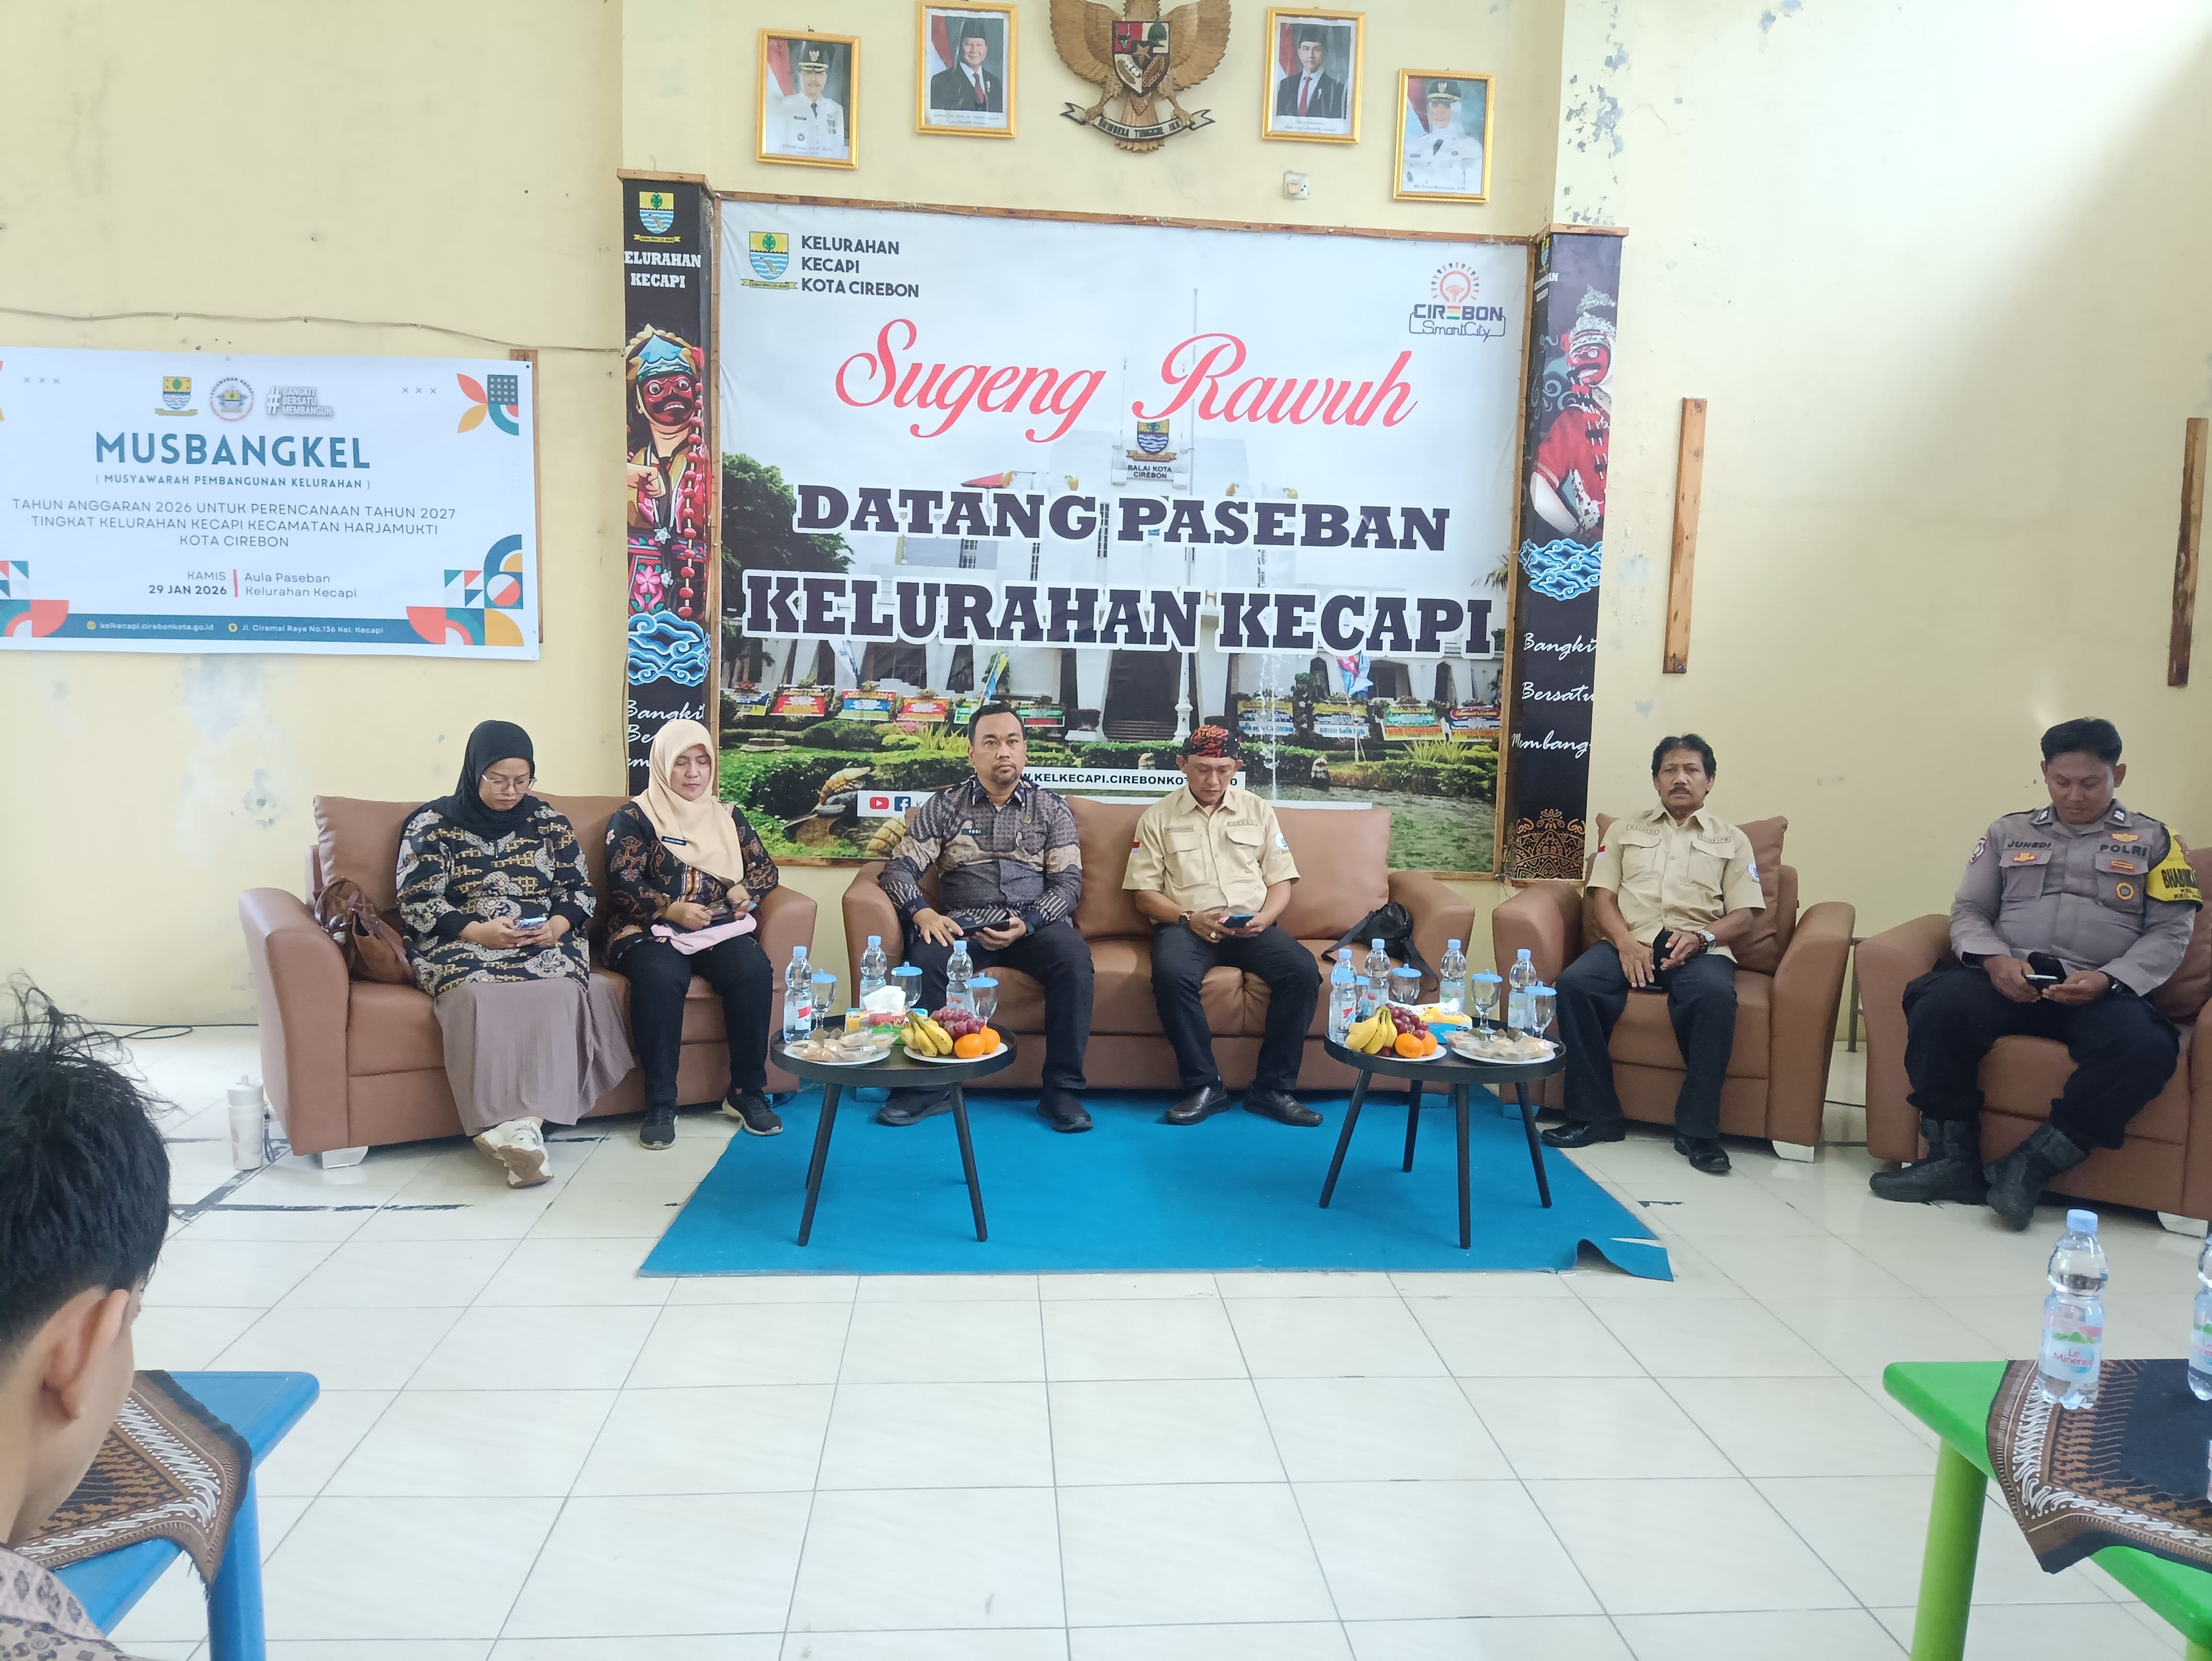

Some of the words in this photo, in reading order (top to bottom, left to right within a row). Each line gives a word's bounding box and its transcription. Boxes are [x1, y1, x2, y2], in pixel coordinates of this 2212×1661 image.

[801, 235, 899, 255] KELURAHAN
[624, 251, 701, 268] ELURAHAN
[801, 257, 860, 274] KECAPI
[630, 273, 686, 288] KECAPI
[801, 277, 846, 294] KOTA
[849, 280, 919, 298] CIREBON
[835, 319, 1106, 443] Sugeng
[1132, 333, 1418, 427] Rawuh
[282, 406, 333, 416] MEMBANGUN
[96, 432, 370, 468] MUSBANGKEL
[104, 475, 189, 484] MUSYAWARAH
[195, 476, 286, 487] PEMBANGUNAN
[292, 478, 362, 488] KELURAHAN
[13, 499, 63, 510] TAHUN
[68, 500, 151, 512] ANGGARAN
[156, 501, 192, 512] 2026
[197, 503, 246, 514] UNTUK
[252, 504, 360, 517] PERENCANAAN
[365, 506, 415, 518] TAHUN
[420, 508, 455, 519] 2027
[32, 516, 95, 527] TINGKAT
[100, 517, 187, 529] KELURAHAN
[192, 519, 243, 530] KECAPI
[249, 520, 339, 532] KECAMATAN
[345, 522, 438, 534] HARJAMUKTI
[797, 485, 1097, 540] DATANG
[1117, 498, 1450, 551] PASEBAN
[180, 535, 219, 546] KOTA
[224, 535, 289, 547] CIREBON
[188, 571, 226, 581] KAMIS
[245, 573, 272, 582] Aula
[276, 573, 330, 583] Paseban
[149, 585, 164, 594] 29
[168, 586, 190, 595] JAN
[195, 586, 227, 595] 2026
[246, 587, 310, 597] Kelurahan
[314, 588, 357, 599] Kecapi
[747, 576, 1201, 647] KELURAHAN
[1219, 593, 1492, 653] KECAPI
[2100, 844, 2147, 857] POLRI
[2053, 1351, 2094, 1366] Minerale
[2068, 1348, 2080, 1358] Le
